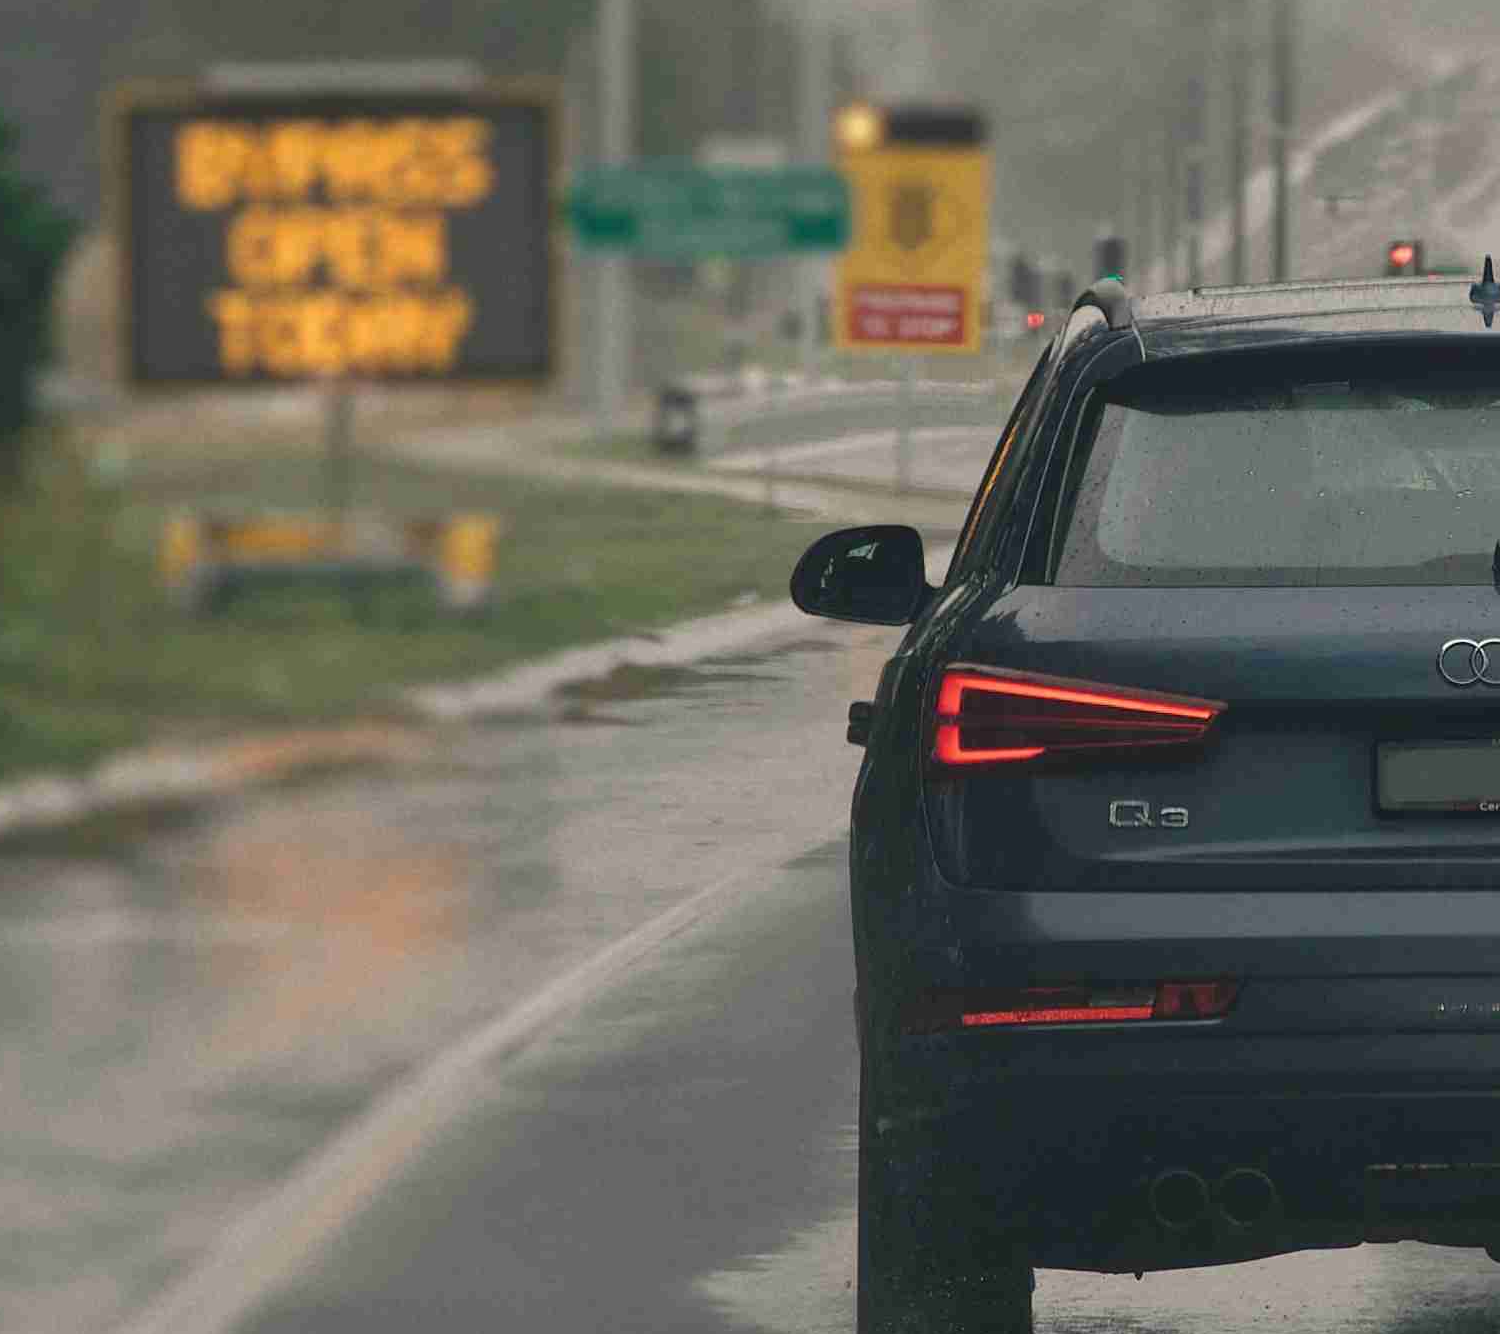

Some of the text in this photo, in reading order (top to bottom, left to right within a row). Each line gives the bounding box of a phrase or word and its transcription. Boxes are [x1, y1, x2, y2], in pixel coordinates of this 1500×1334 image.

[175, 119, 494, 209] BYPASS
[227, 210, 446, 286] OPEN
[210, 287, 472, 375] TODAY
[1108, 799, 1189, 828] Q3
